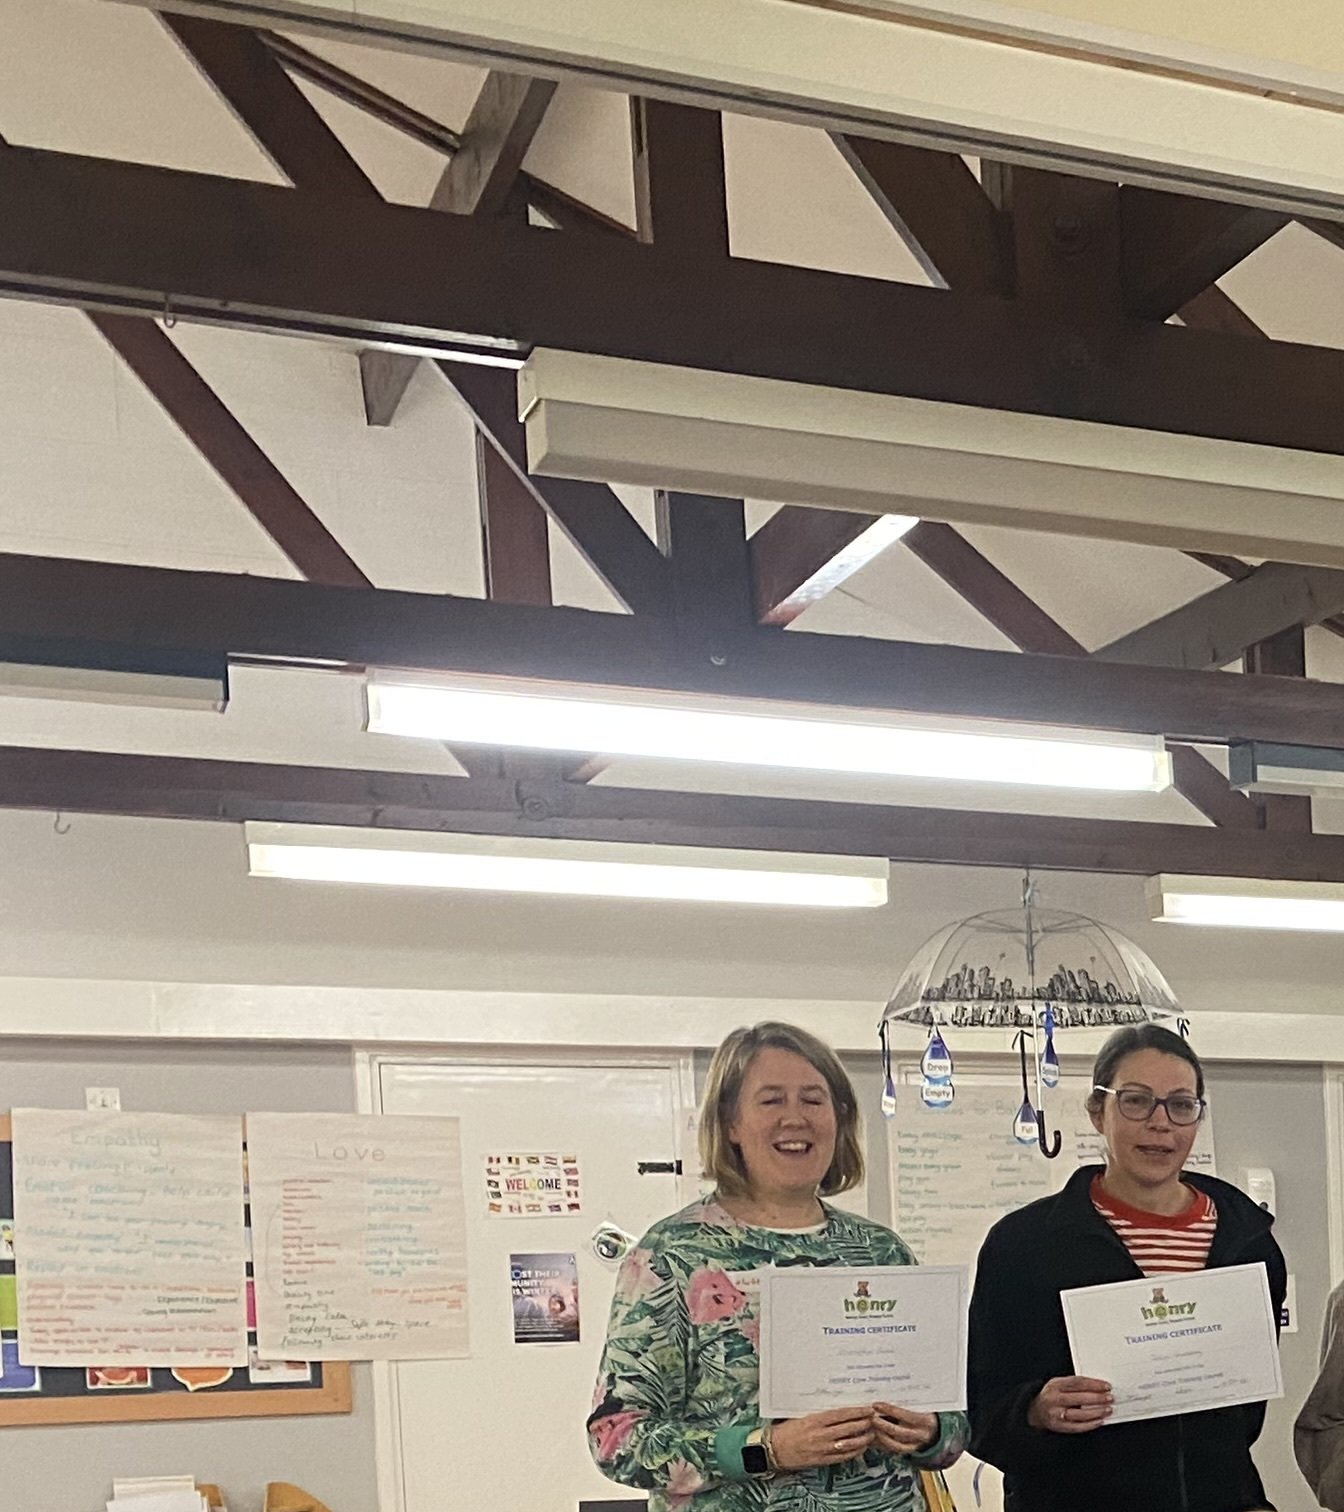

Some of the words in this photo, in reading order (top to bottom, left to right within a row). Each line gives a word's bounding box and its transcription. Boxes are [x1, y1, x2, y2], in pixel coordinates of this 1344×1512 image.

[925, 1088, 950, 1098] Empty
[70, 1128, 160, 1156] Empathy
[315, 1141, 385, 1162] Love
[505, 1179, 562, 1190] WELCOME
[844, 1298, 897, 1313] henry
[1141, 1301, 1196, 1320] henry
